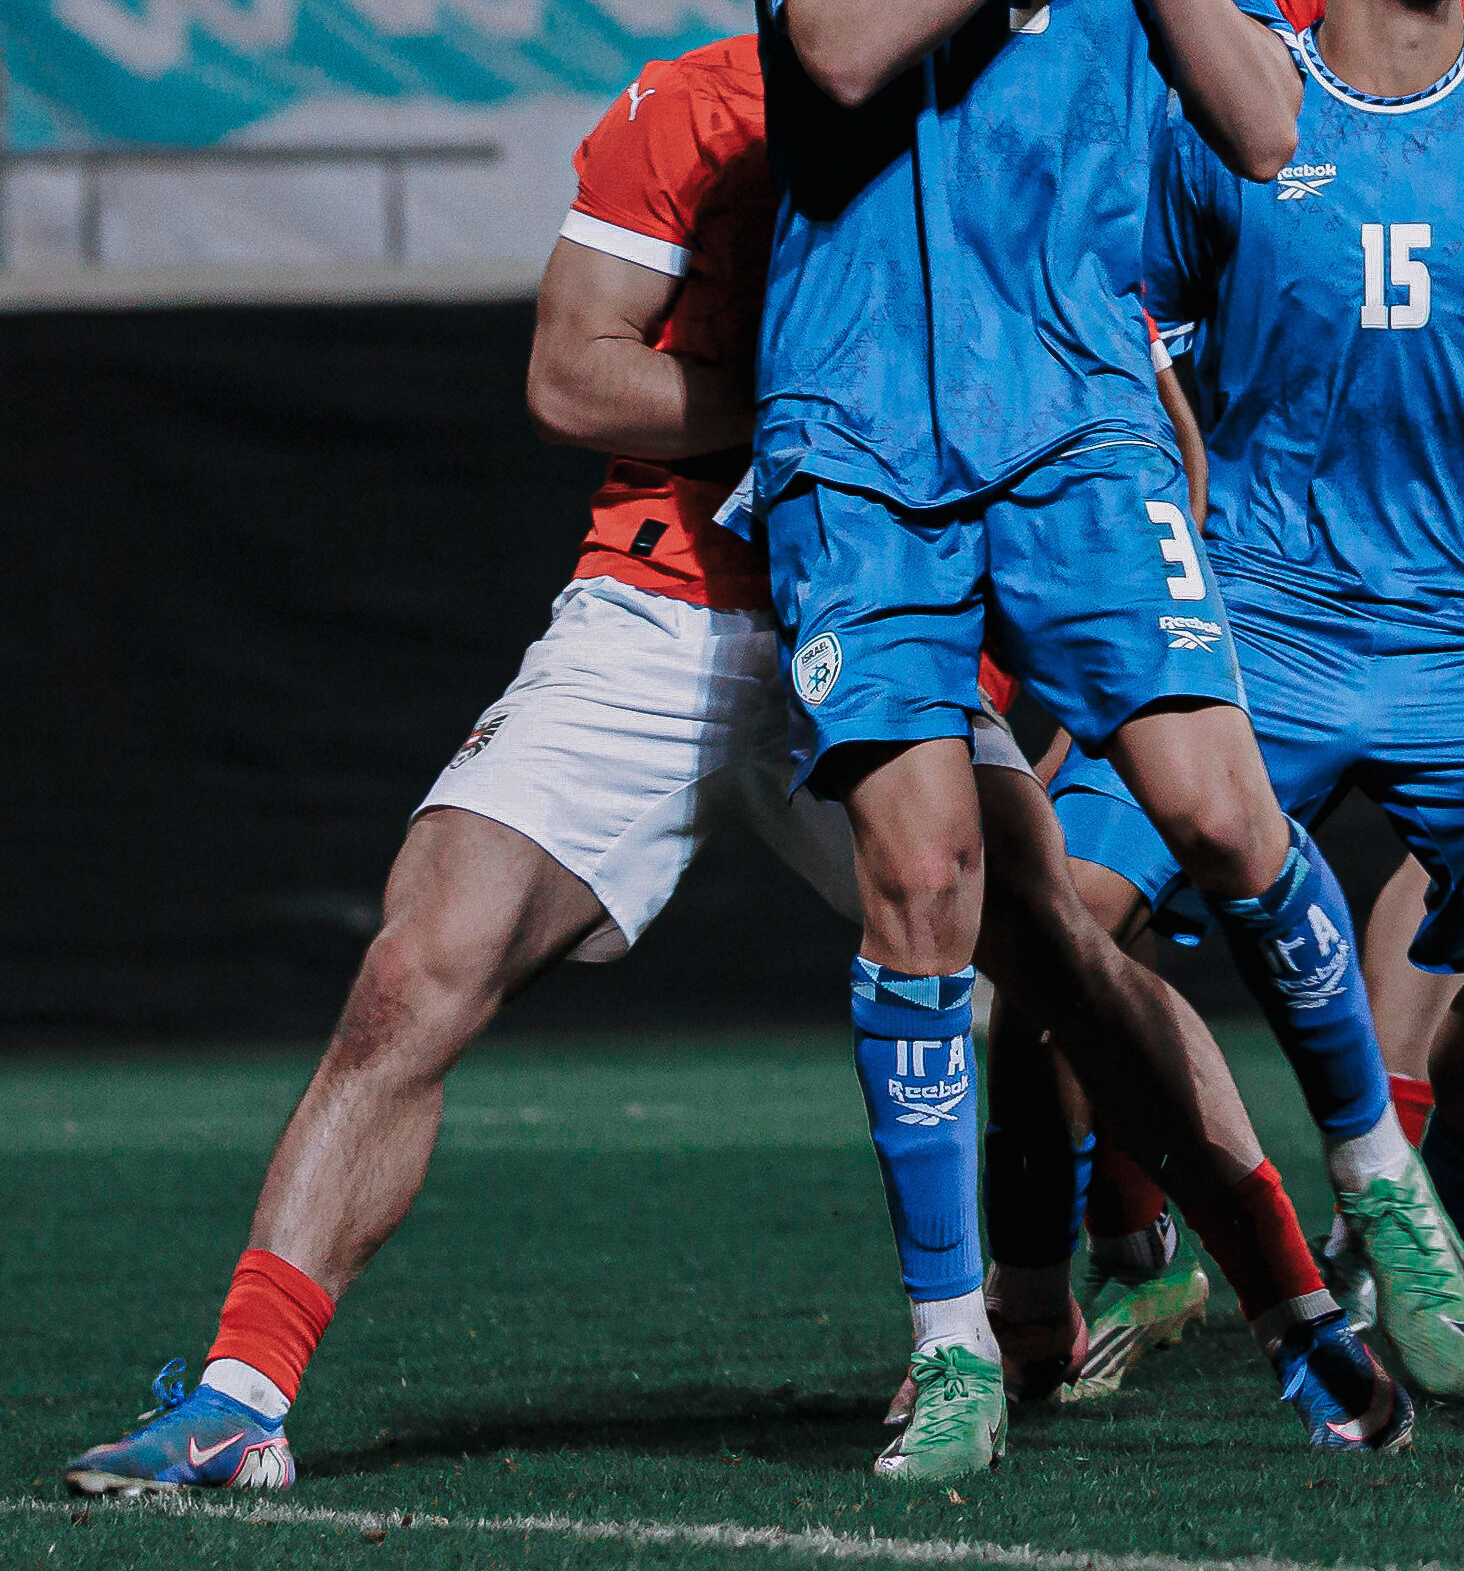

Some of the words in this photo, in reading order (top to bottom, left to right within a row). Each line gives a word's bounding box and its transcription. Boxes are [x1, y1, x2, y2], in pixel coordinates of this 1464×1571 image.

[1360, 222, 1432, 330] 15
[1144, 500, 1207, 601] 3
[801, 641, 829, 665] ISRAEL
